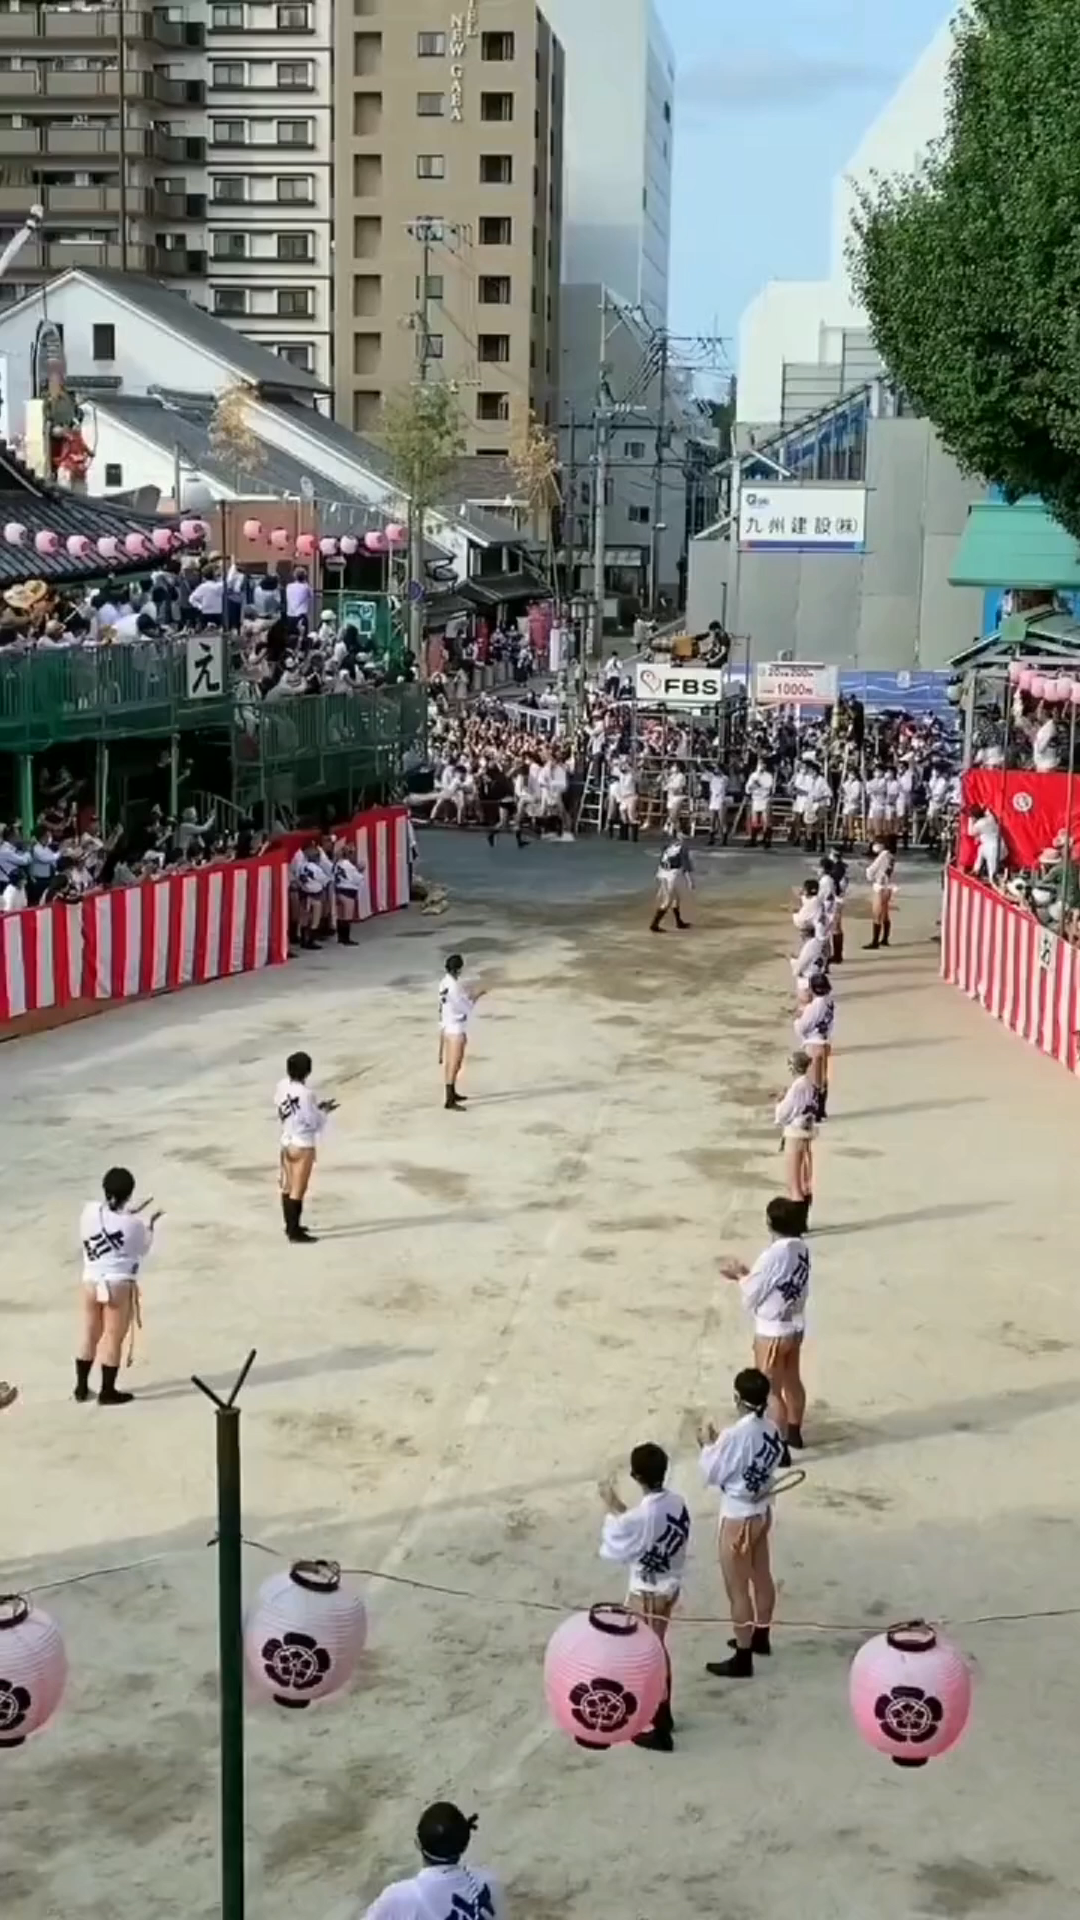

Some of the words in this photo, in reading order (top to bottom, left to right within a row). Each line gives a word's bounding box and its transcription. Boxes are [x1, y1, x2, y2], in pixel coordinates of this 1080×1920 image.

[450, 13, 465, 57] NEW
[192, 642, 220, 694] え
[664, 679, 718, 695] FBS
